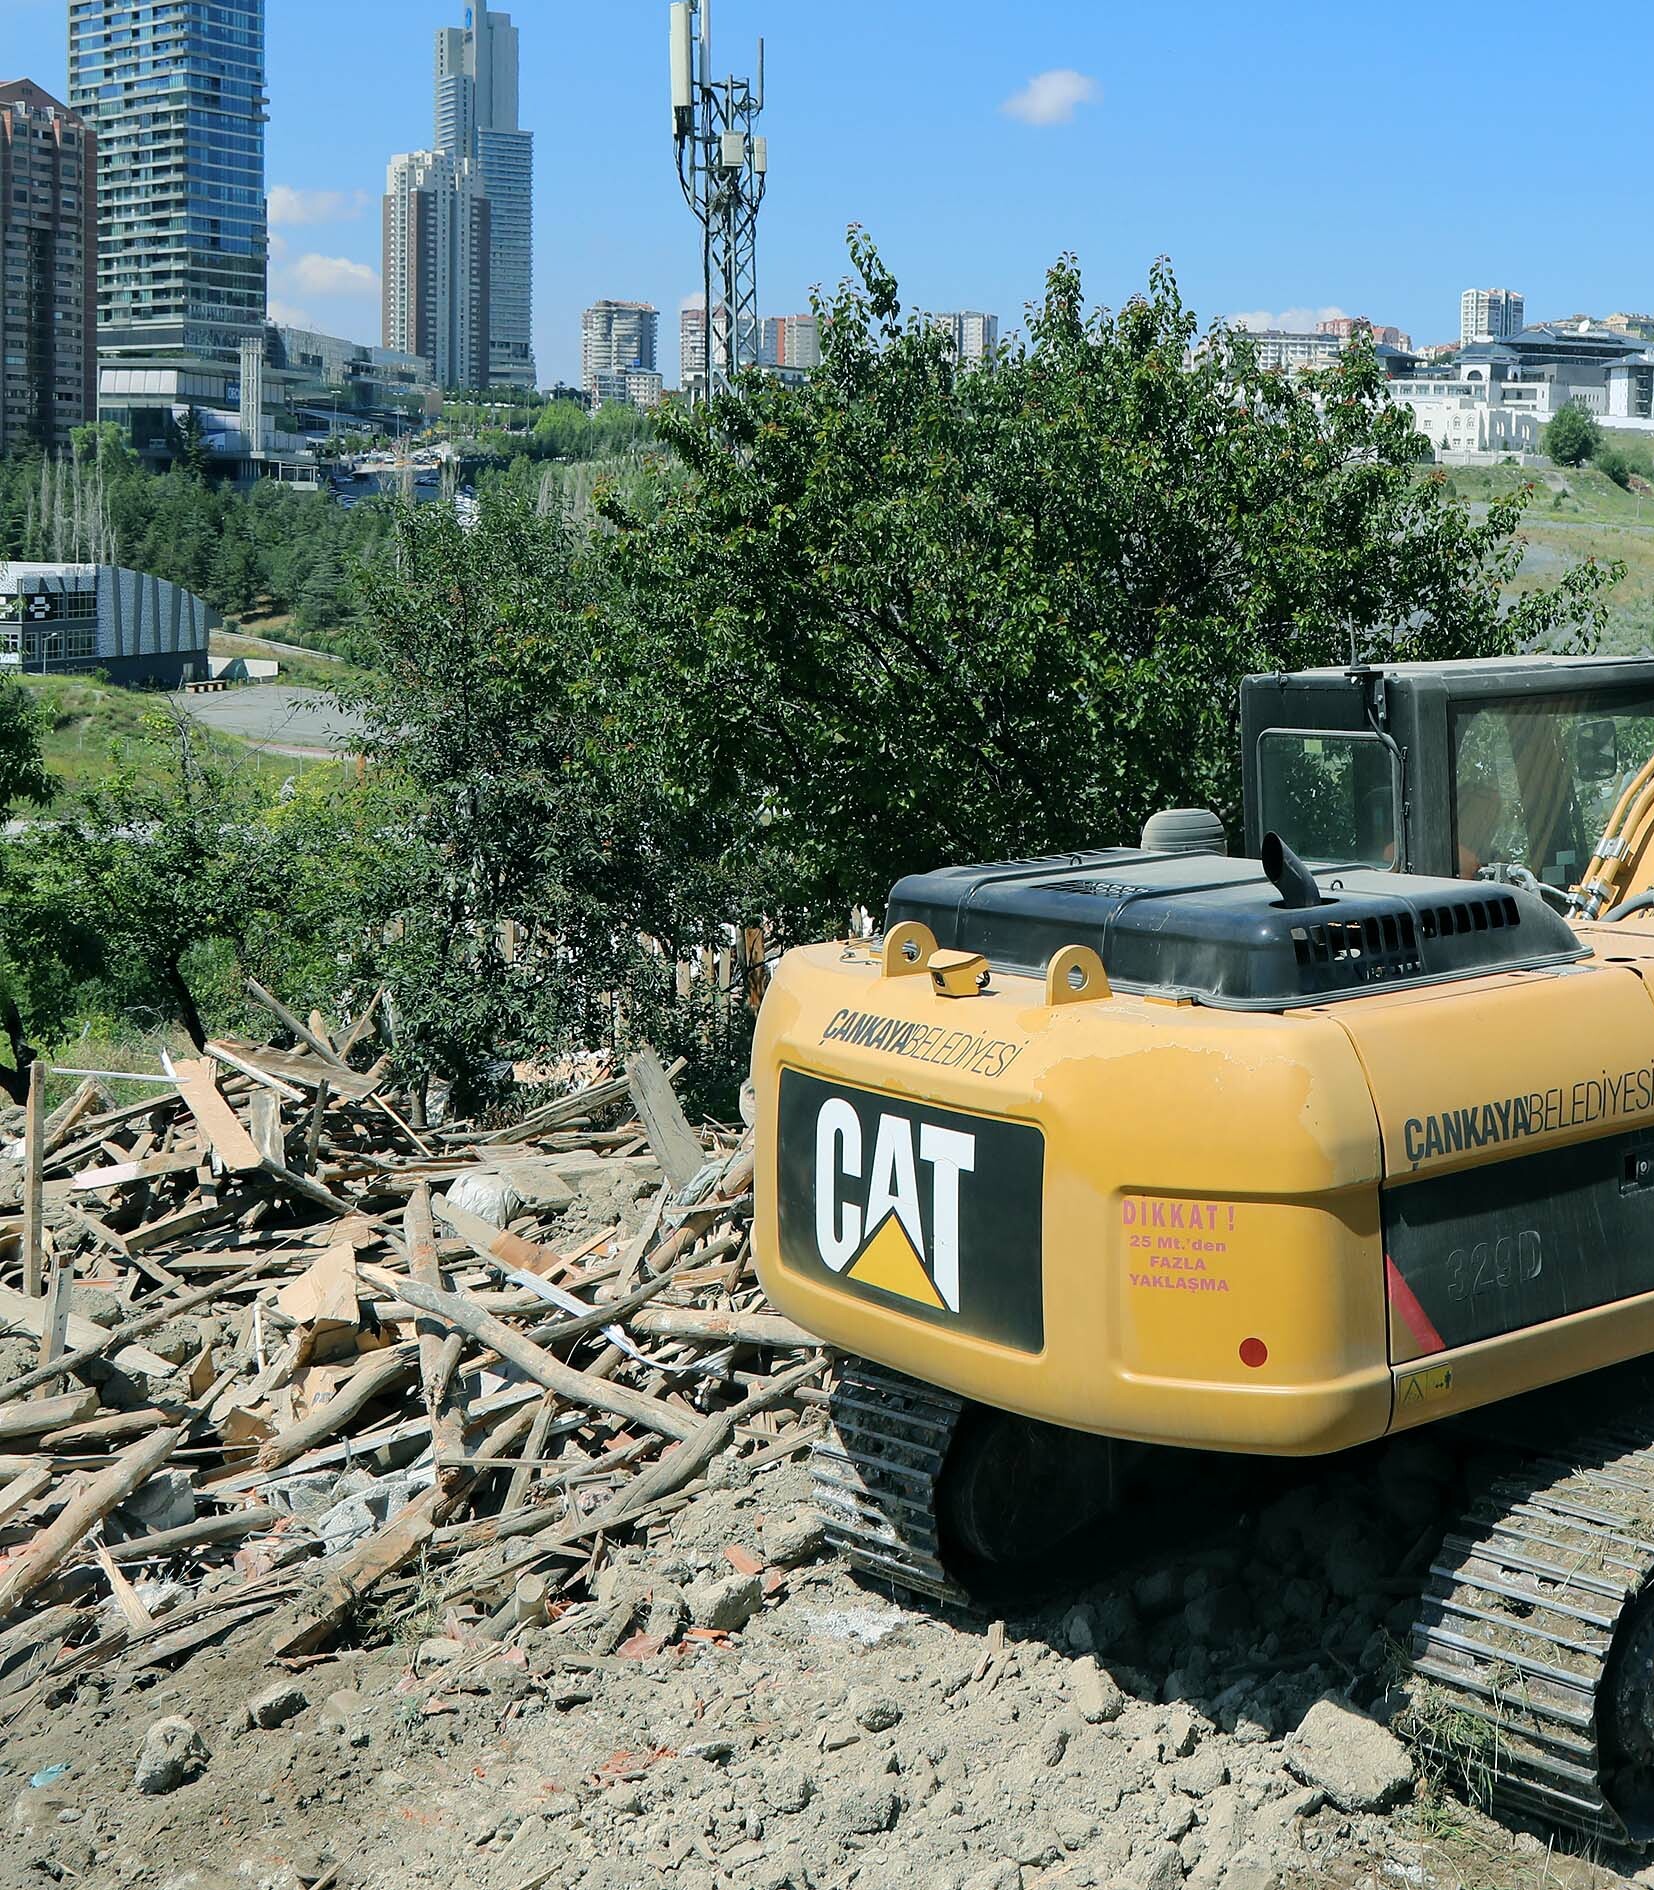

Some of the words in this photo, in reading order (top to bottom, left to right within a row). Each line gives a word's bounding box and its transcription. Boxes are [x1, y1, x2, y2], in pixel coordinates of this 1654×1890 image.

[815, 1097, 976, 1314] CAT
[1129, 1235, 1152, 1248] 25
[1149, 1256, 1207, 1271] FAZLA
[1447, 1230, 1543, 1301] 329D
[1128, 1273, 1230, 1294] YAKLAŞMA
